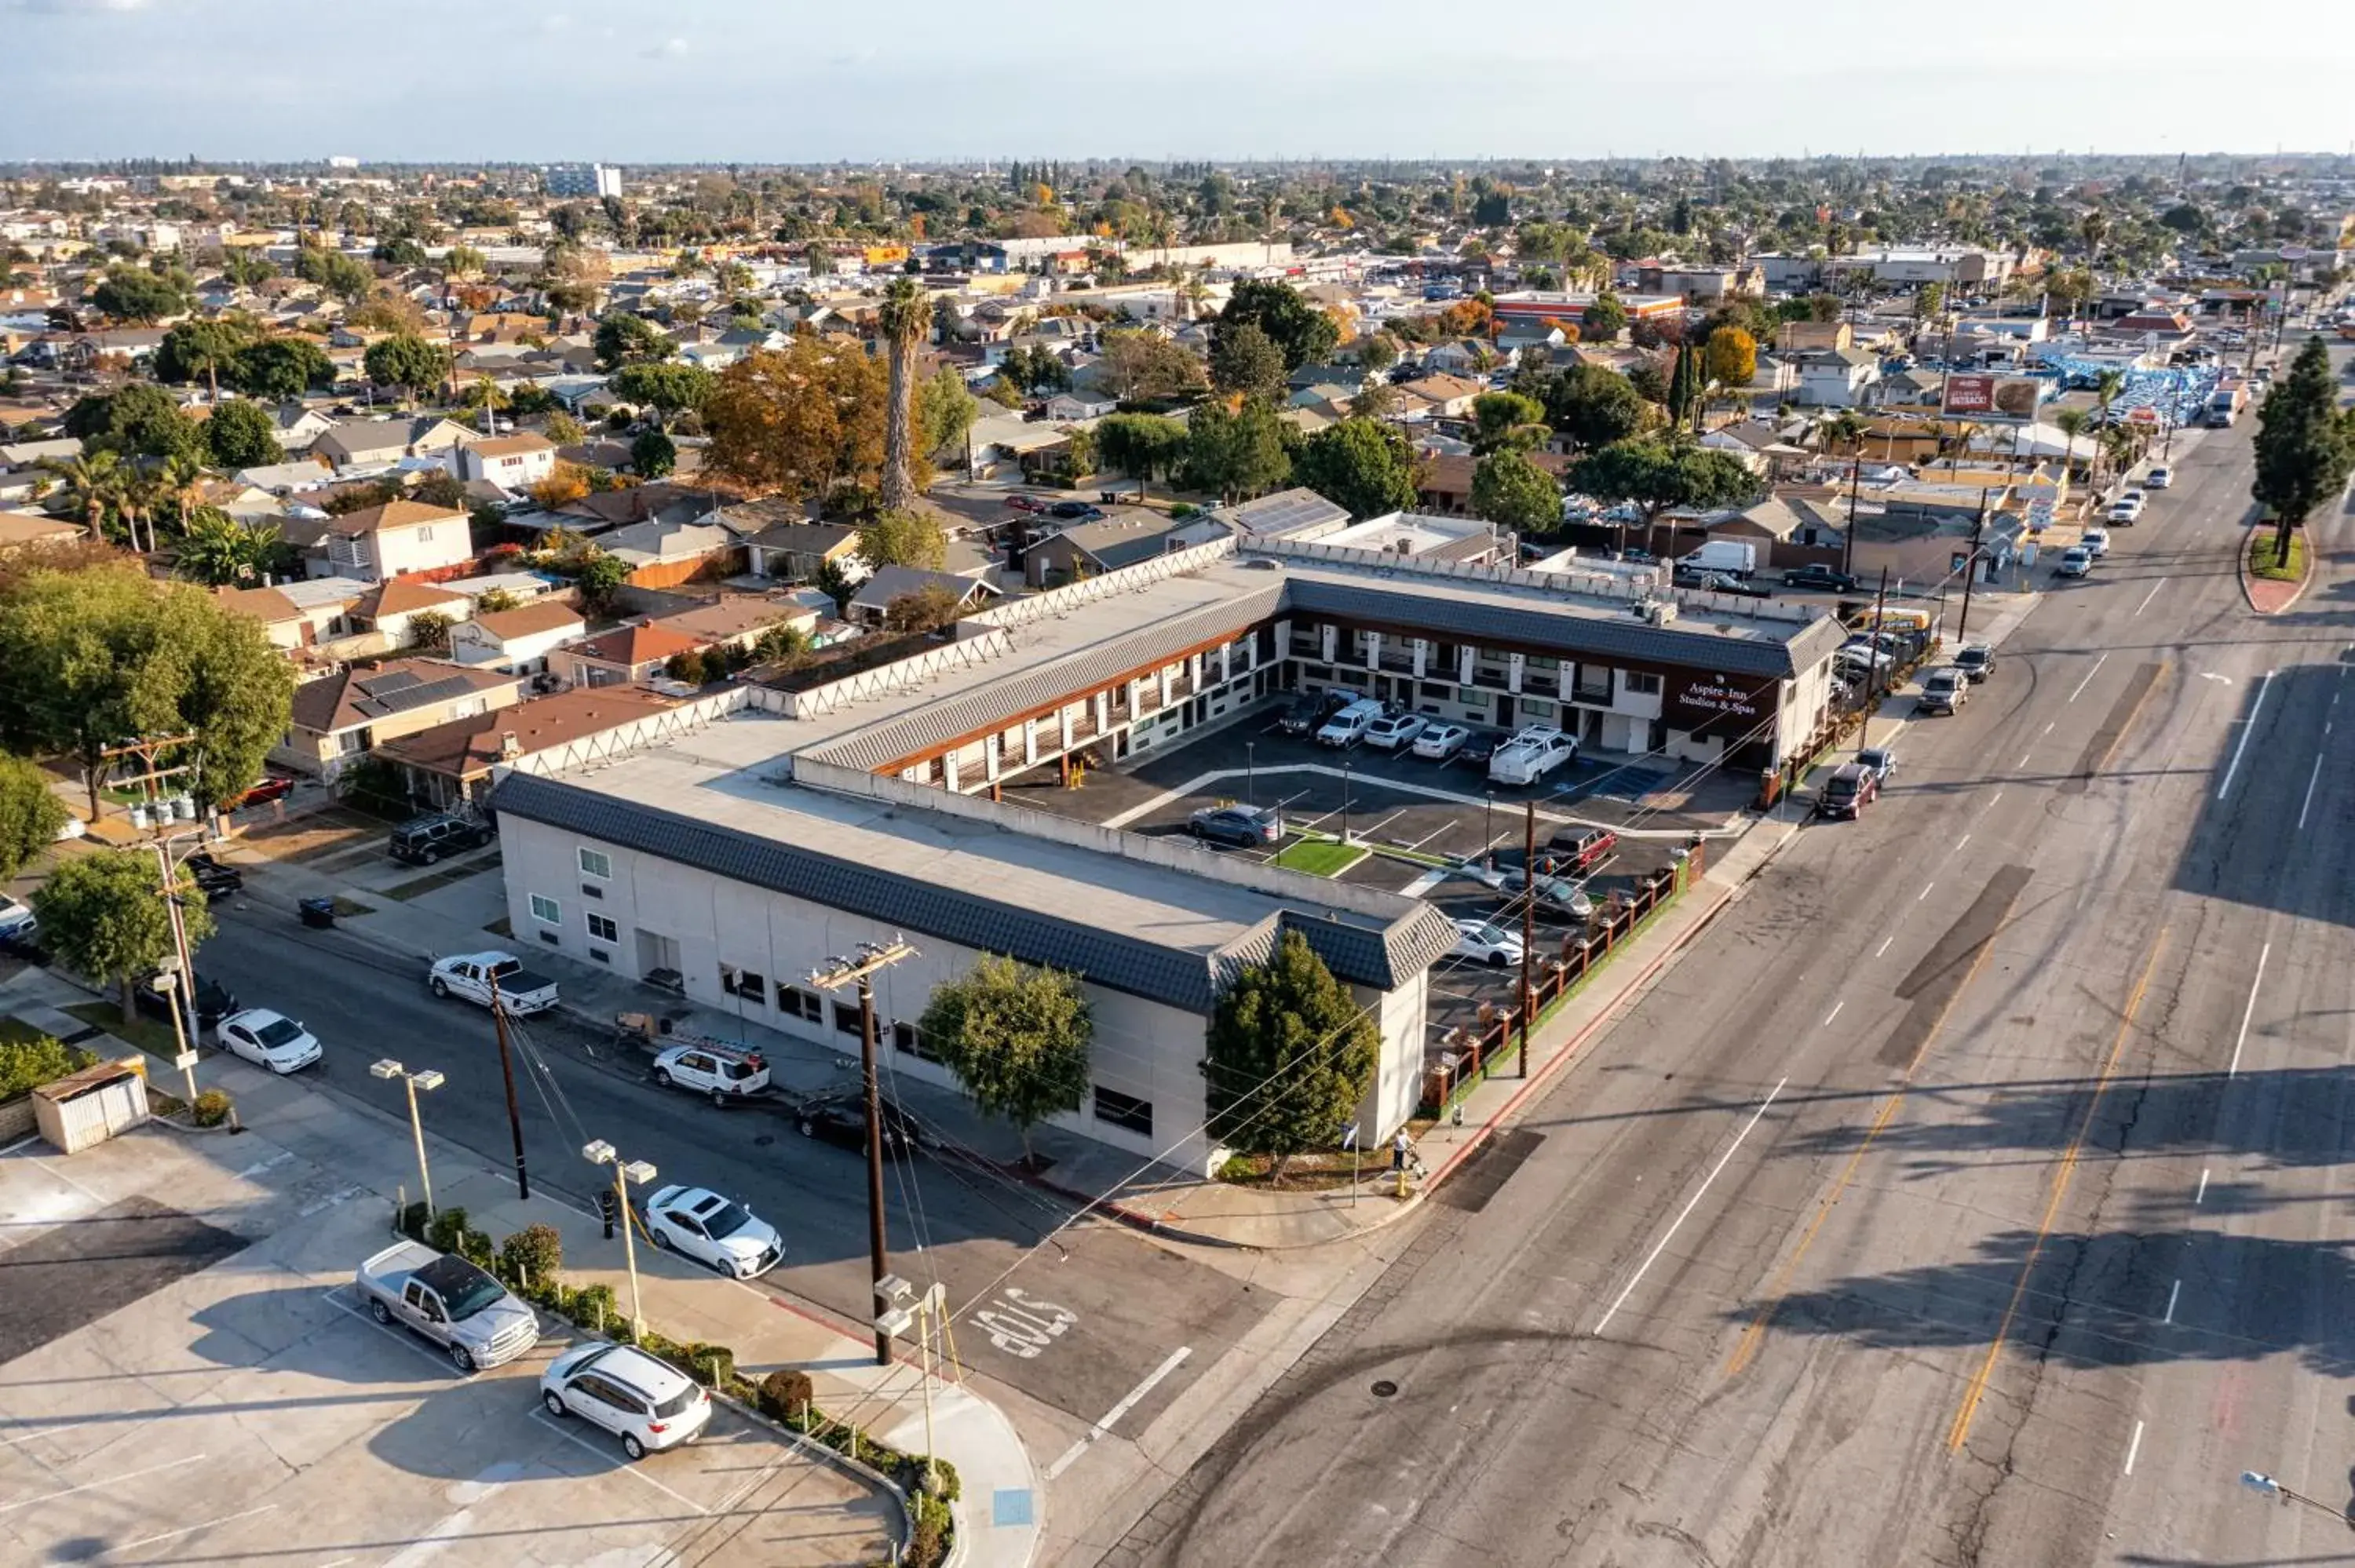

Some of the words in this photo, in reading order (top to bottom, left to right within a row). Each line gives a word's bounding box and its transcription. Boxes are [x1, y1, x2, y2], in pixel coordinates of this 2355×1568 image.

[1689, 683, 1723, 696] Aspire
[1729, 688, 1747, 699] Inn
[1679, 693, 1716, 708] Studios
[1719, 700, 1729, 710] &
[1732, 702, 1755, 715] Spas
[969, 1288, 1079, 1358] STOP
